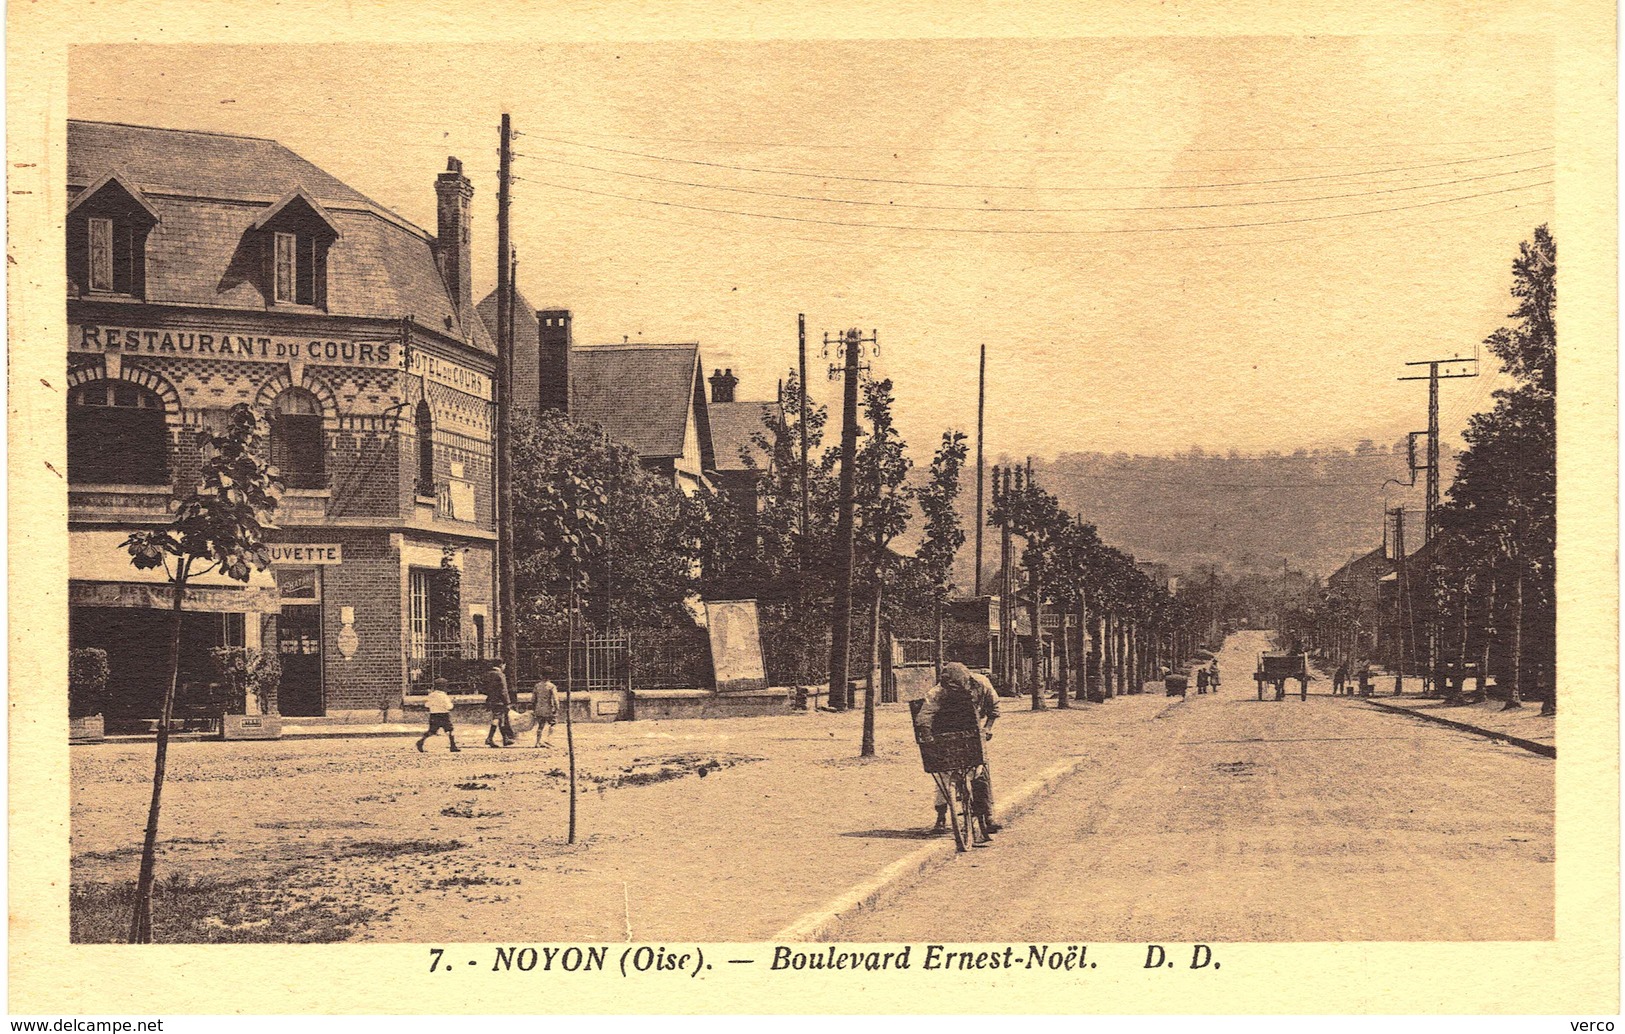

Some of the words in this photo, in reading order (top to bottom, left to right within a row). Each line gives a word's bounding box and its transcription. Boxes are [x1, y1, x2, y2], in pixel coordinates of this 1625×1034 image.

[80, 325, 271, 356] RESTAURANT
[276, 343, 299, 357] DU
[307, 341, 390, 362] COURS
[453, 367, 482, 394] COURS
[266, 547, 336, 560] UVETTE
